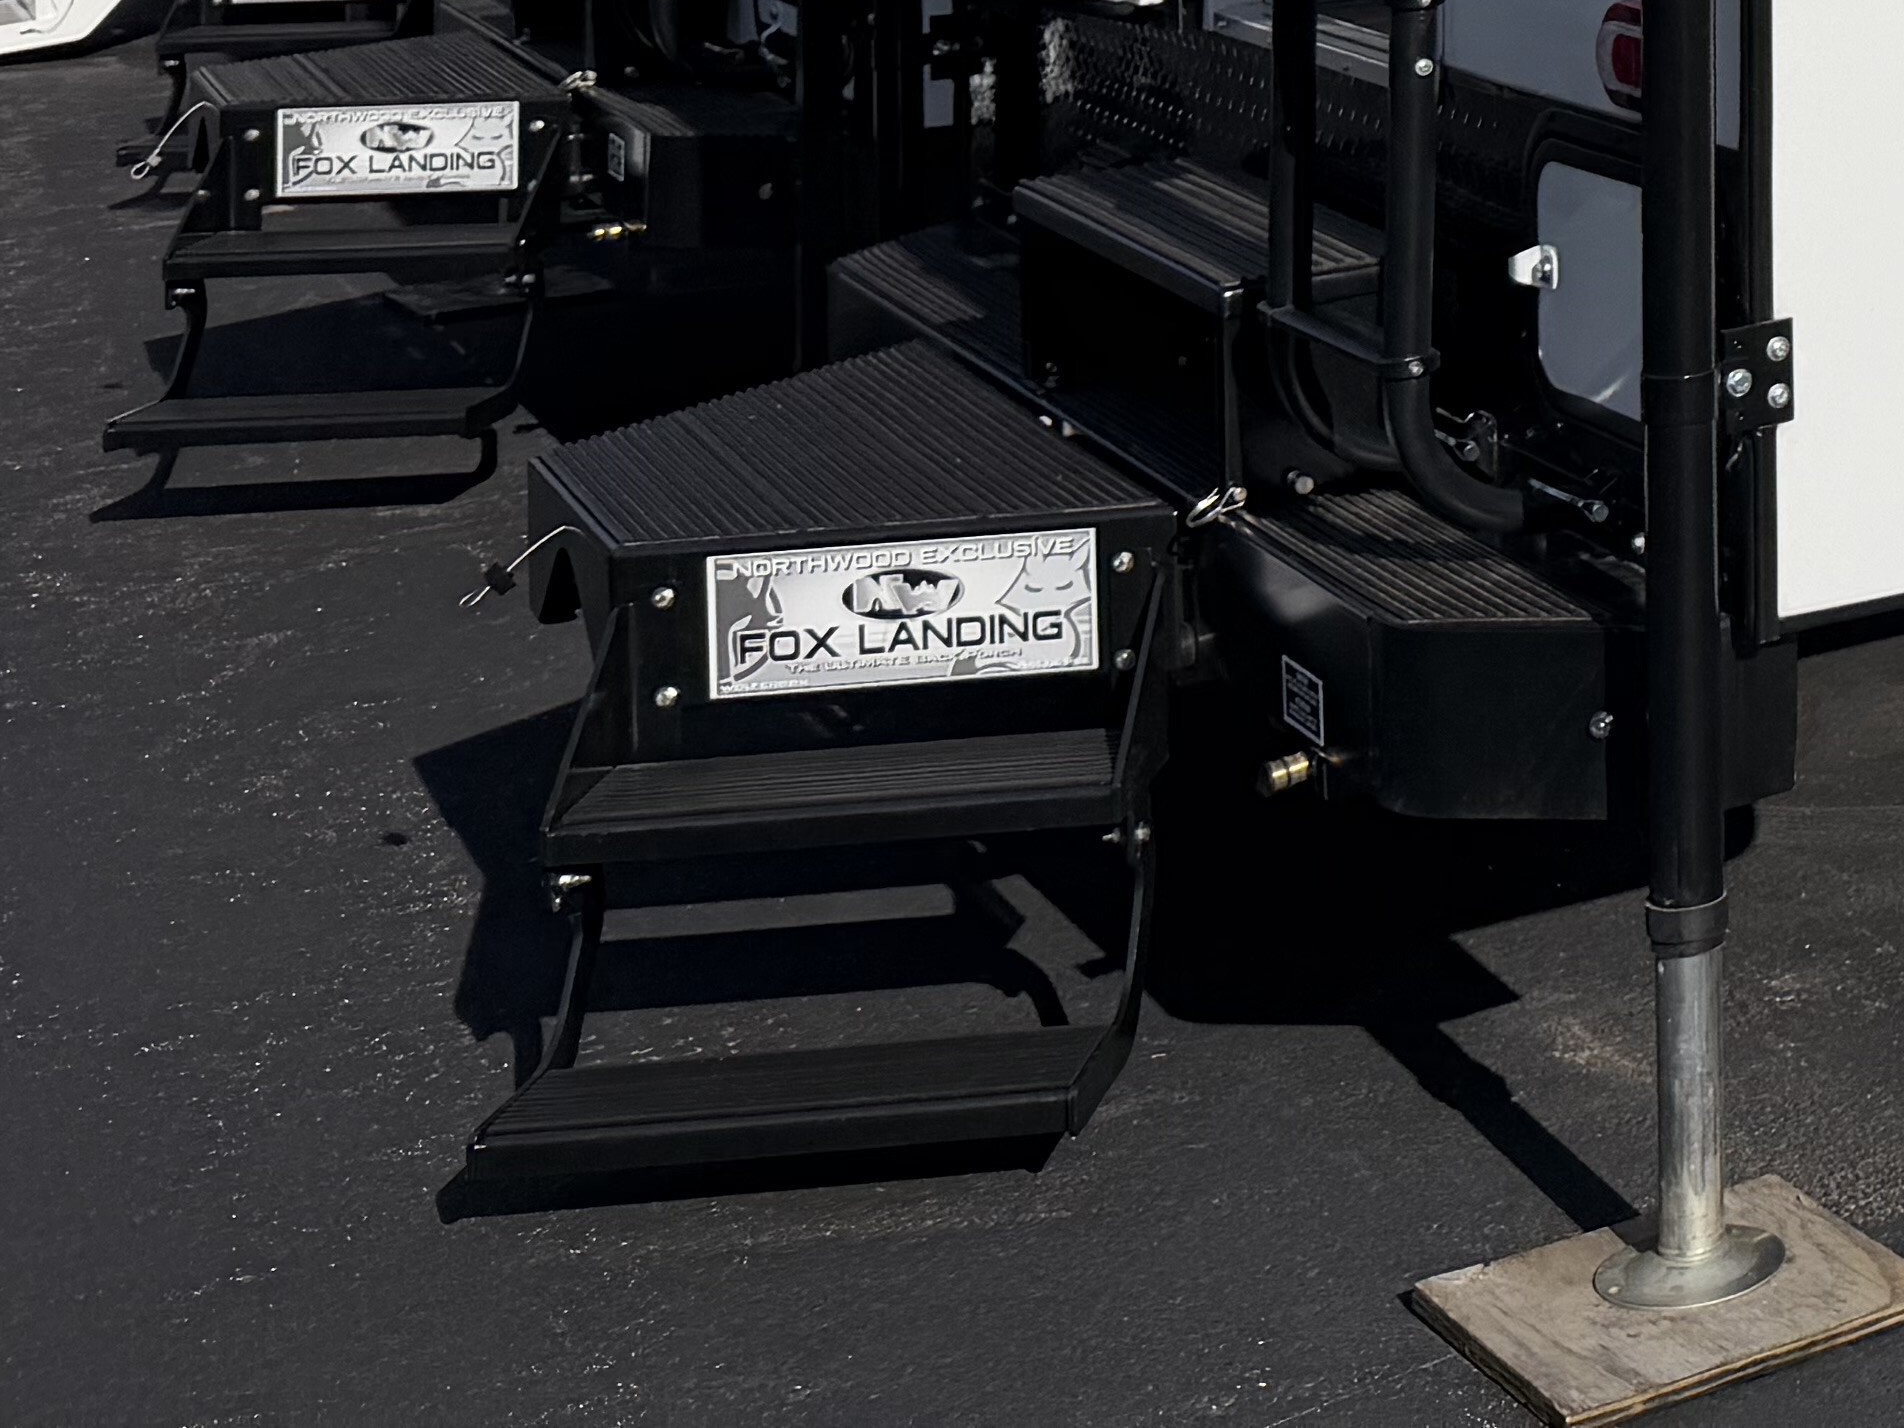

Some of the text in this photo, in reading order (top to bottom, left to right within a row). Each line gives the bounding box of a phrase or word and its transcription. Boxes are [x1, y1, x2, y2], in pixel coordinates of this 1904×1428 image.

[296, 151, 496, 177] FOX LANDING
[733, 537, 1075, 578] NORTHWOOD EXCLUSIVE
[739, 610, 1064, 665] FOX LANDING
